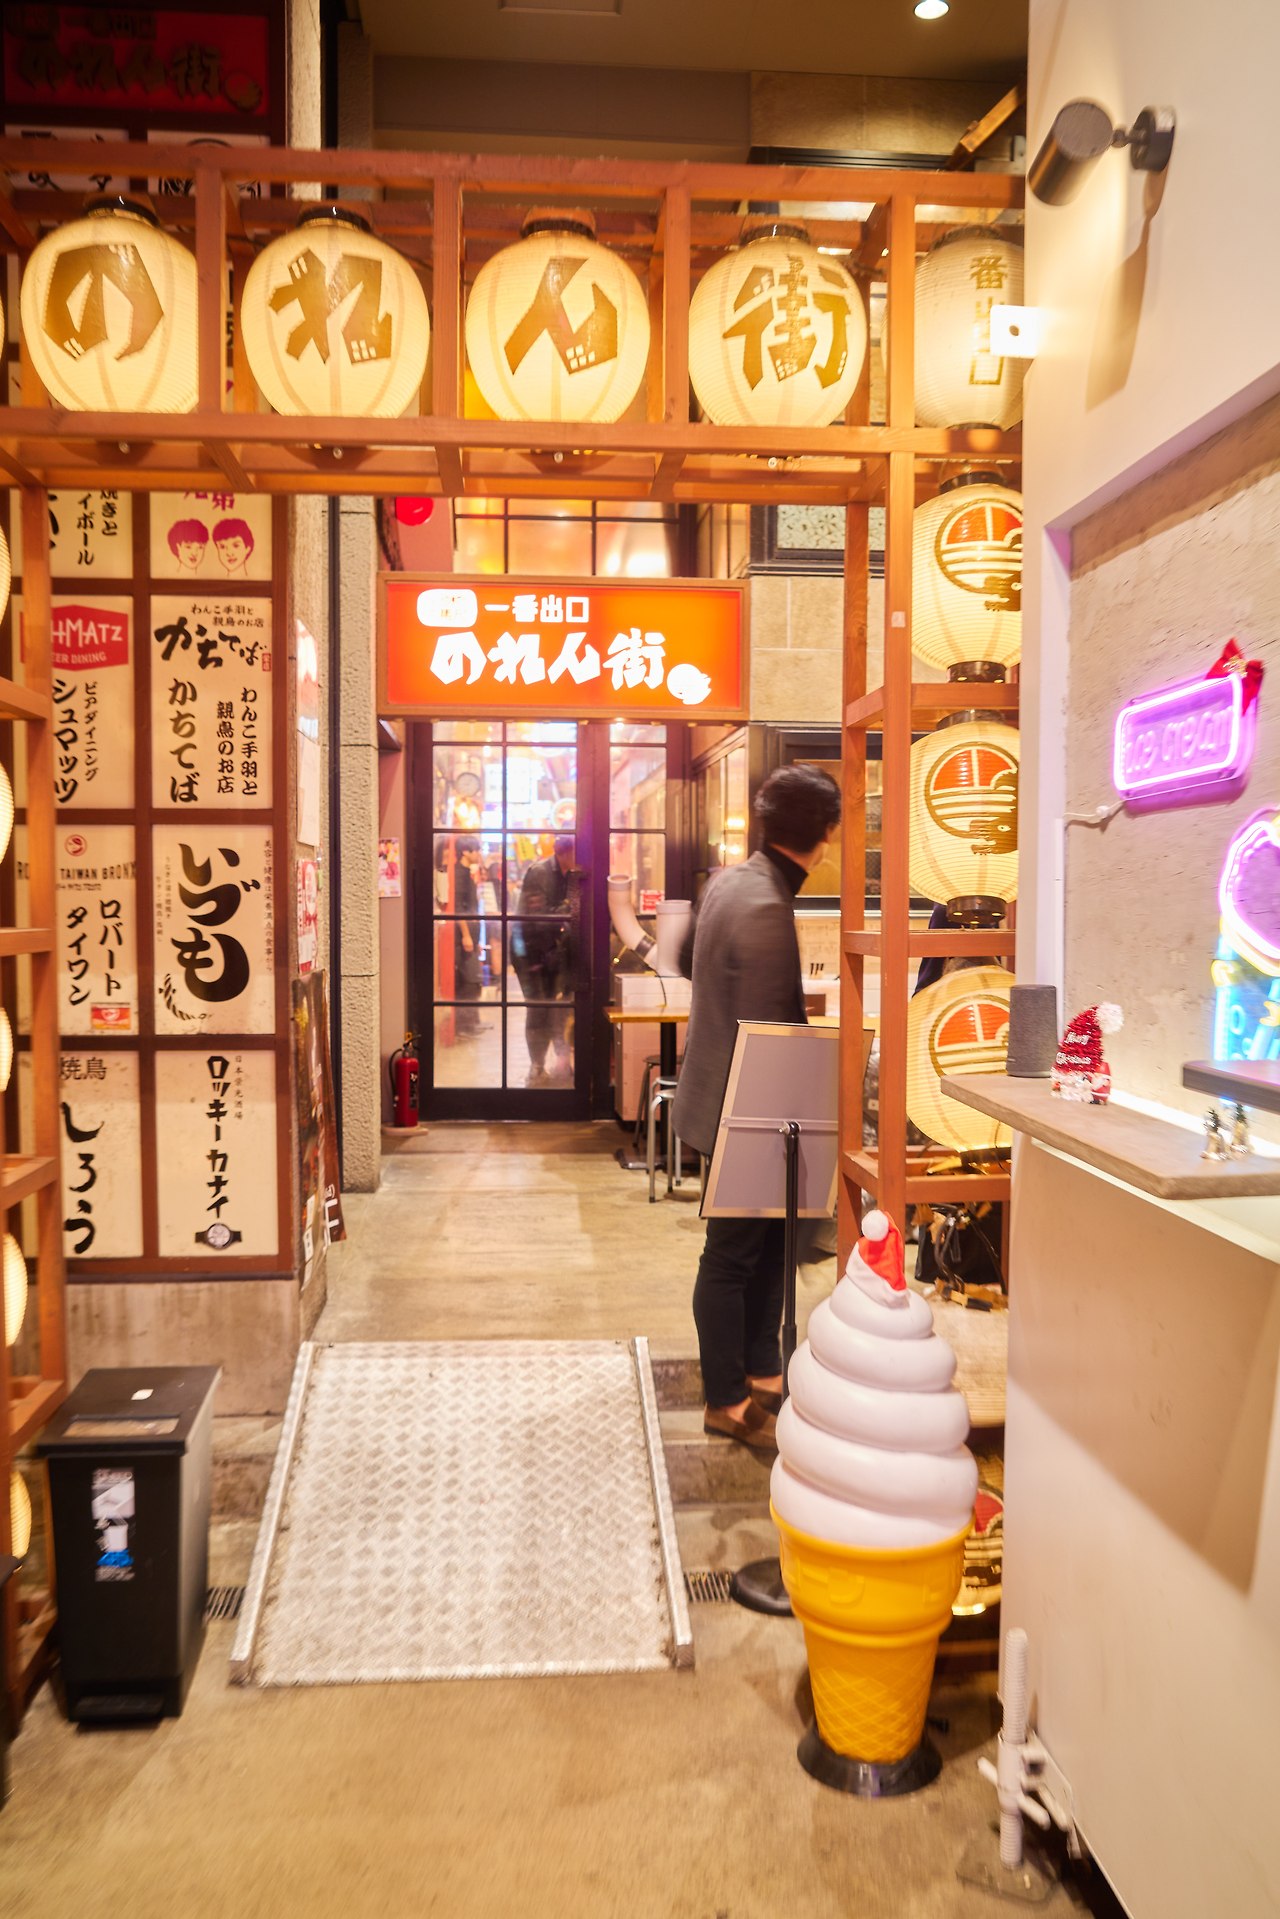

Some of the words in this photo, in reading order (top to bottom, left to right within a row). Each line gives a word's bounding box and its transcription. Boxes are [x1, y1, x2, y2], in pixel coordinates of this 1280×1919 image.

[43, 243, 164, 361] の
[267, 247, 393, 366] れ
[504, 256, 618, 376] ん
[723, 254, 851, 391] 街
[154, 616, 267, 670] かちてば
[191, 604, 254, 615] わんこ手羽と
[484, 594, 590, 623] 一番出口
[71, 652, 107, 665] DINING
[430, 628, 666, 690] のれん街
[53, 679, 78, 803] シュマッツ
[85, 681, 98, 782] ビアダイニング
[168, 678, 200, 803] かちてば
[216, 701, 235, 793] 親鳥のお店
[241, 687, 258, 795] わんこ手羽と
[60, 867, 98, 880] TAIWAN
[171, 843, 261, 1003] いづも
[67, 906, 91, 1006] タイワン
[99, 899, 123, 997] ロバート
[60, 1056, 107, 1081] 焼鳥
[61, 1102, 105, 1255] しろう
[206, 1055, 231, 1219] ロッキーカナイ
